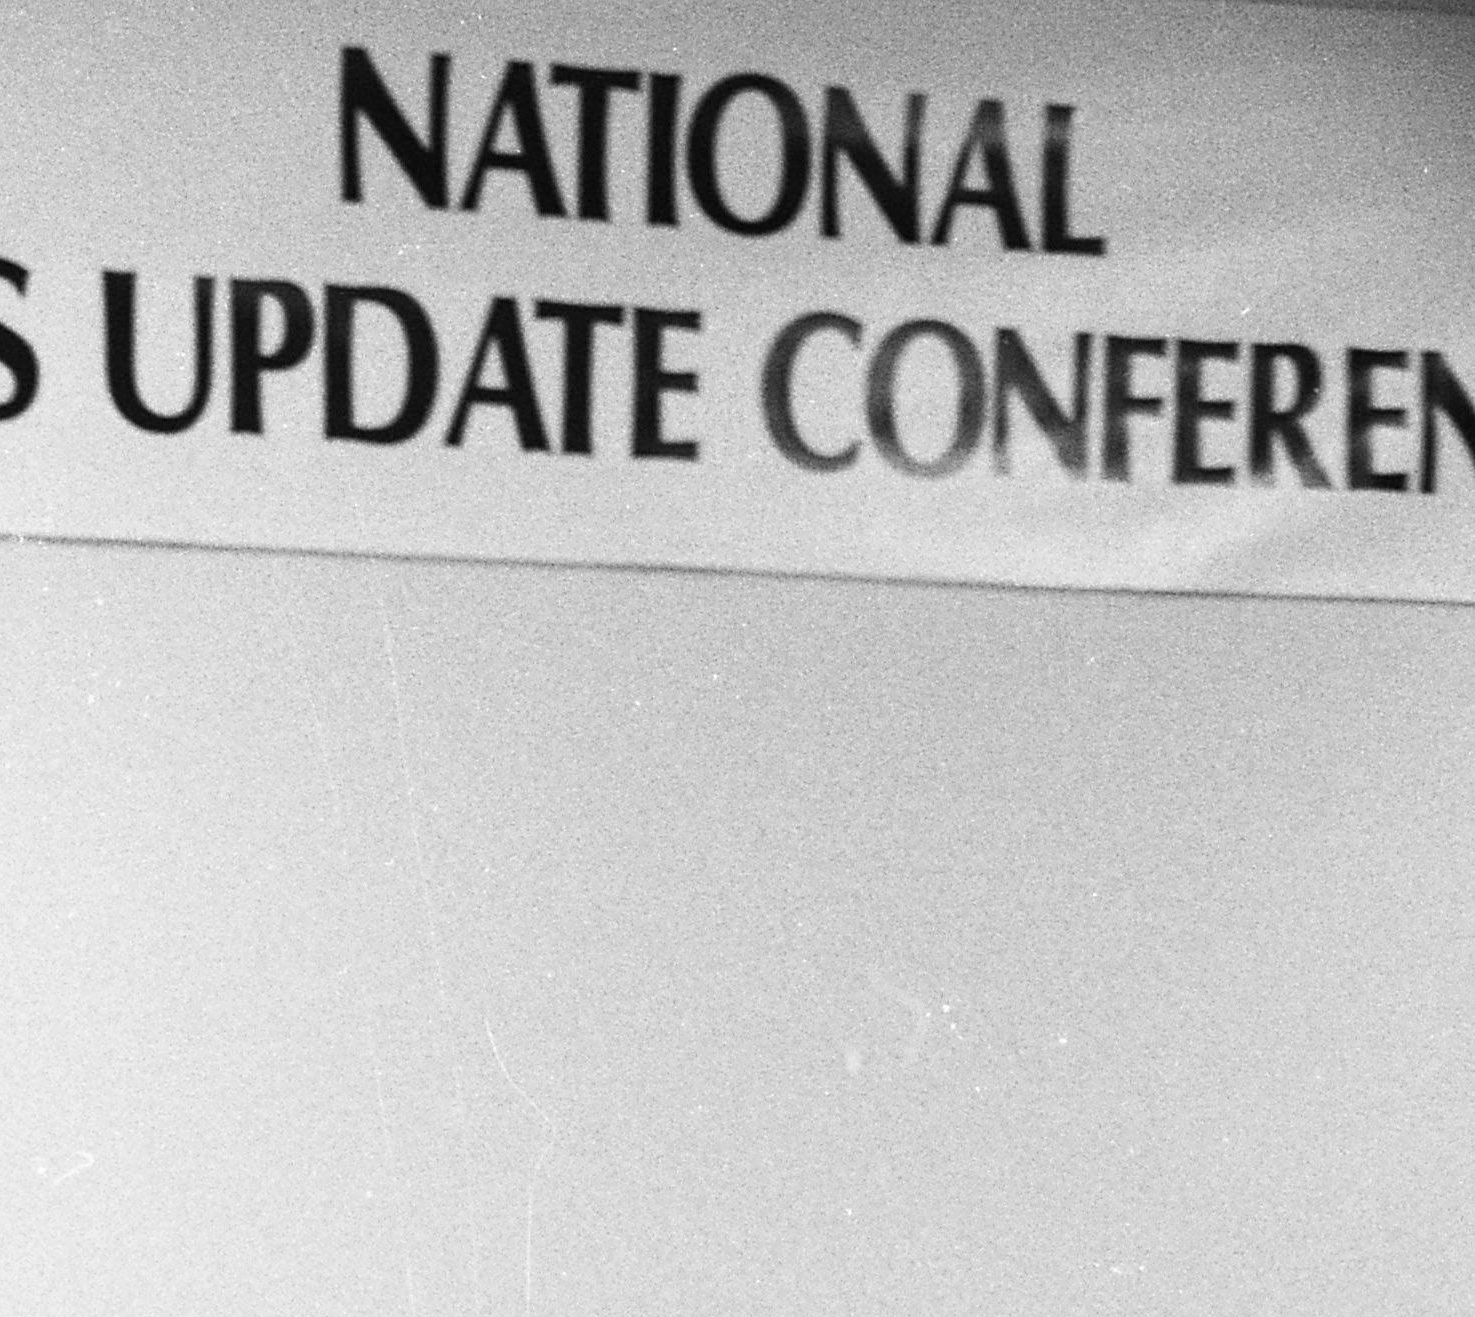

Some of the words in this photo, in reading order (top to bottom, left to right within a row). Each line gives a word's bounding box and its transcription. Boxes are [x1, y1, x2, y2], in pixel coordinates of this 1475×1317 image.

[340, 46, 1106, 256] NATIONAL
[104, 271, 700, 460] UPDATE
[763, 311, 1475, 494] CONFEREN
